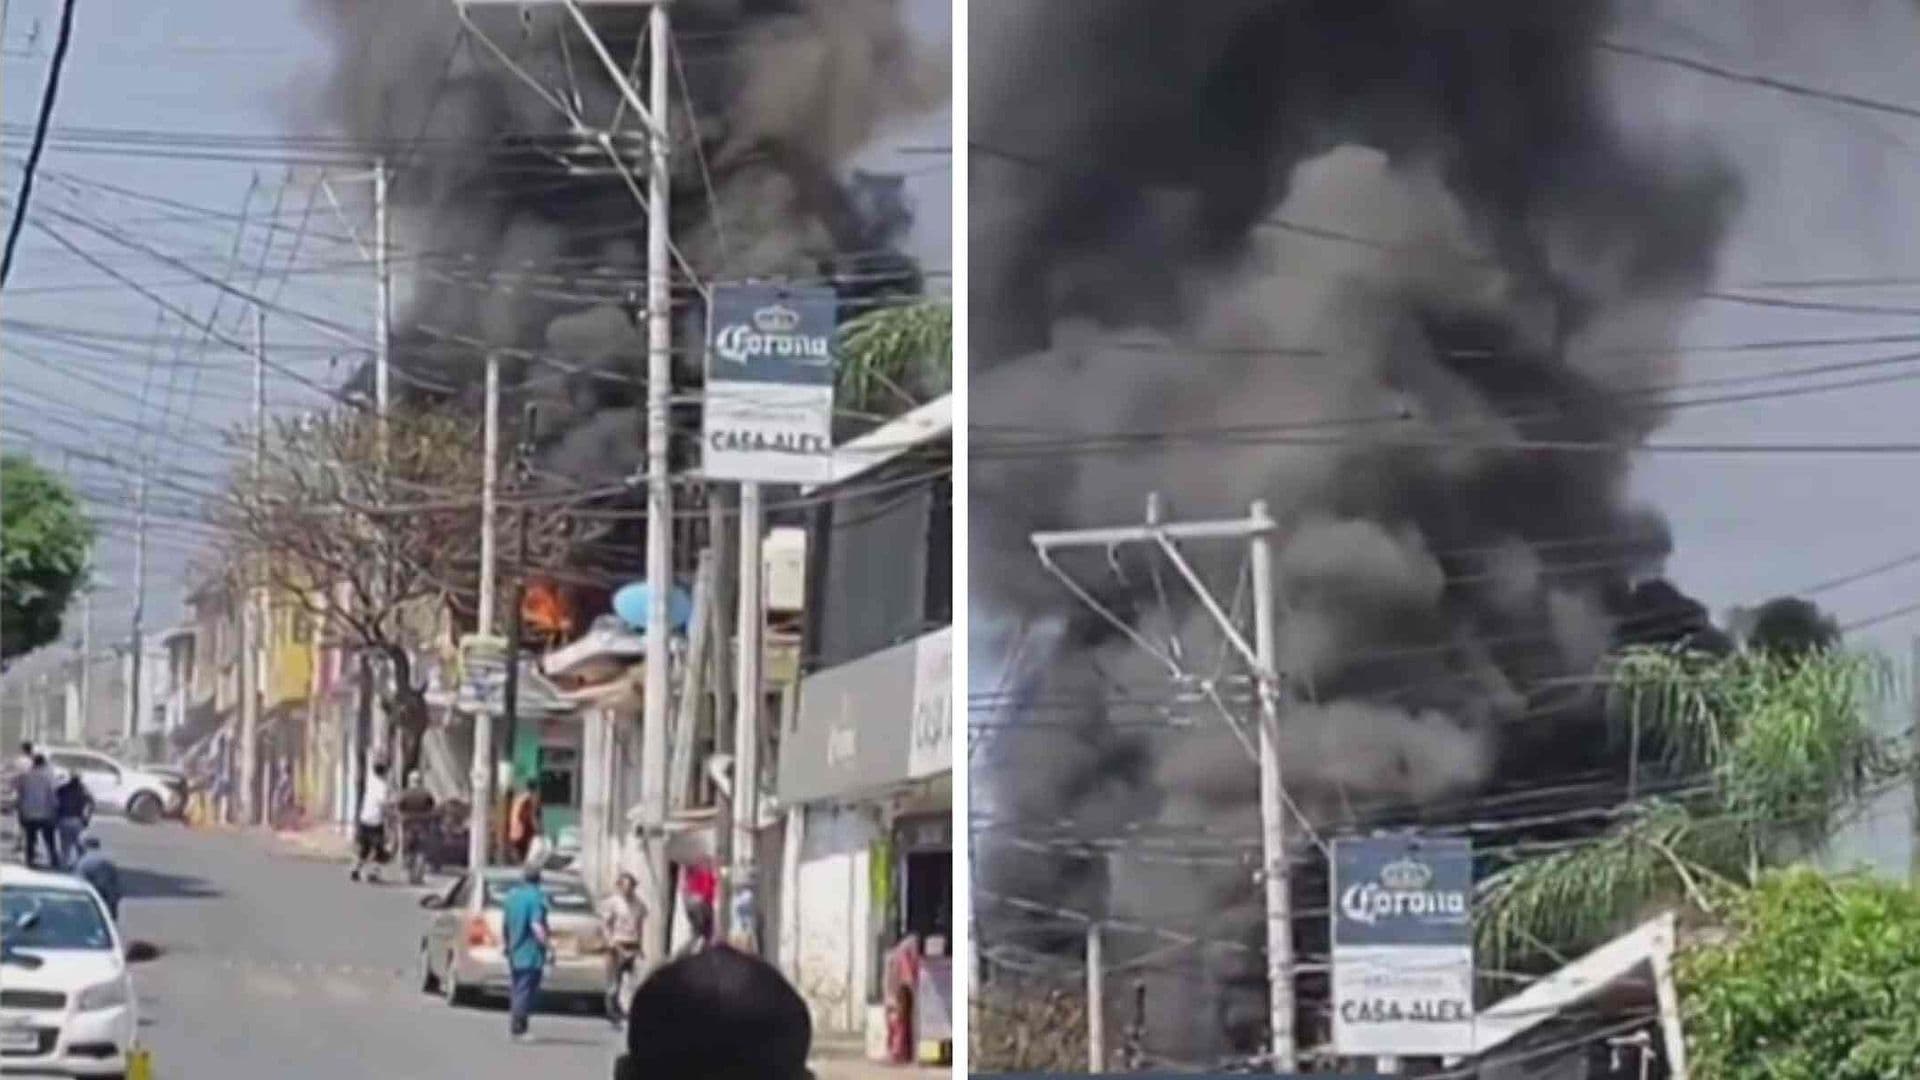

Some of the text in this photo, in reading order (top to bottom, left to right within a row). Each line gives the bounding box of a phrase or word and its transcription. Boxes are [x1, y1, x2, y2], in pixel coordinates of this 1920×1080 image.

[716, 324, 829, 365] Corona
[711, 430, 824, 454] CASA ALEX
[1342, 882, 1468, 925] Corona
[1341, 999, 1465, 1022] CASA ALEX
